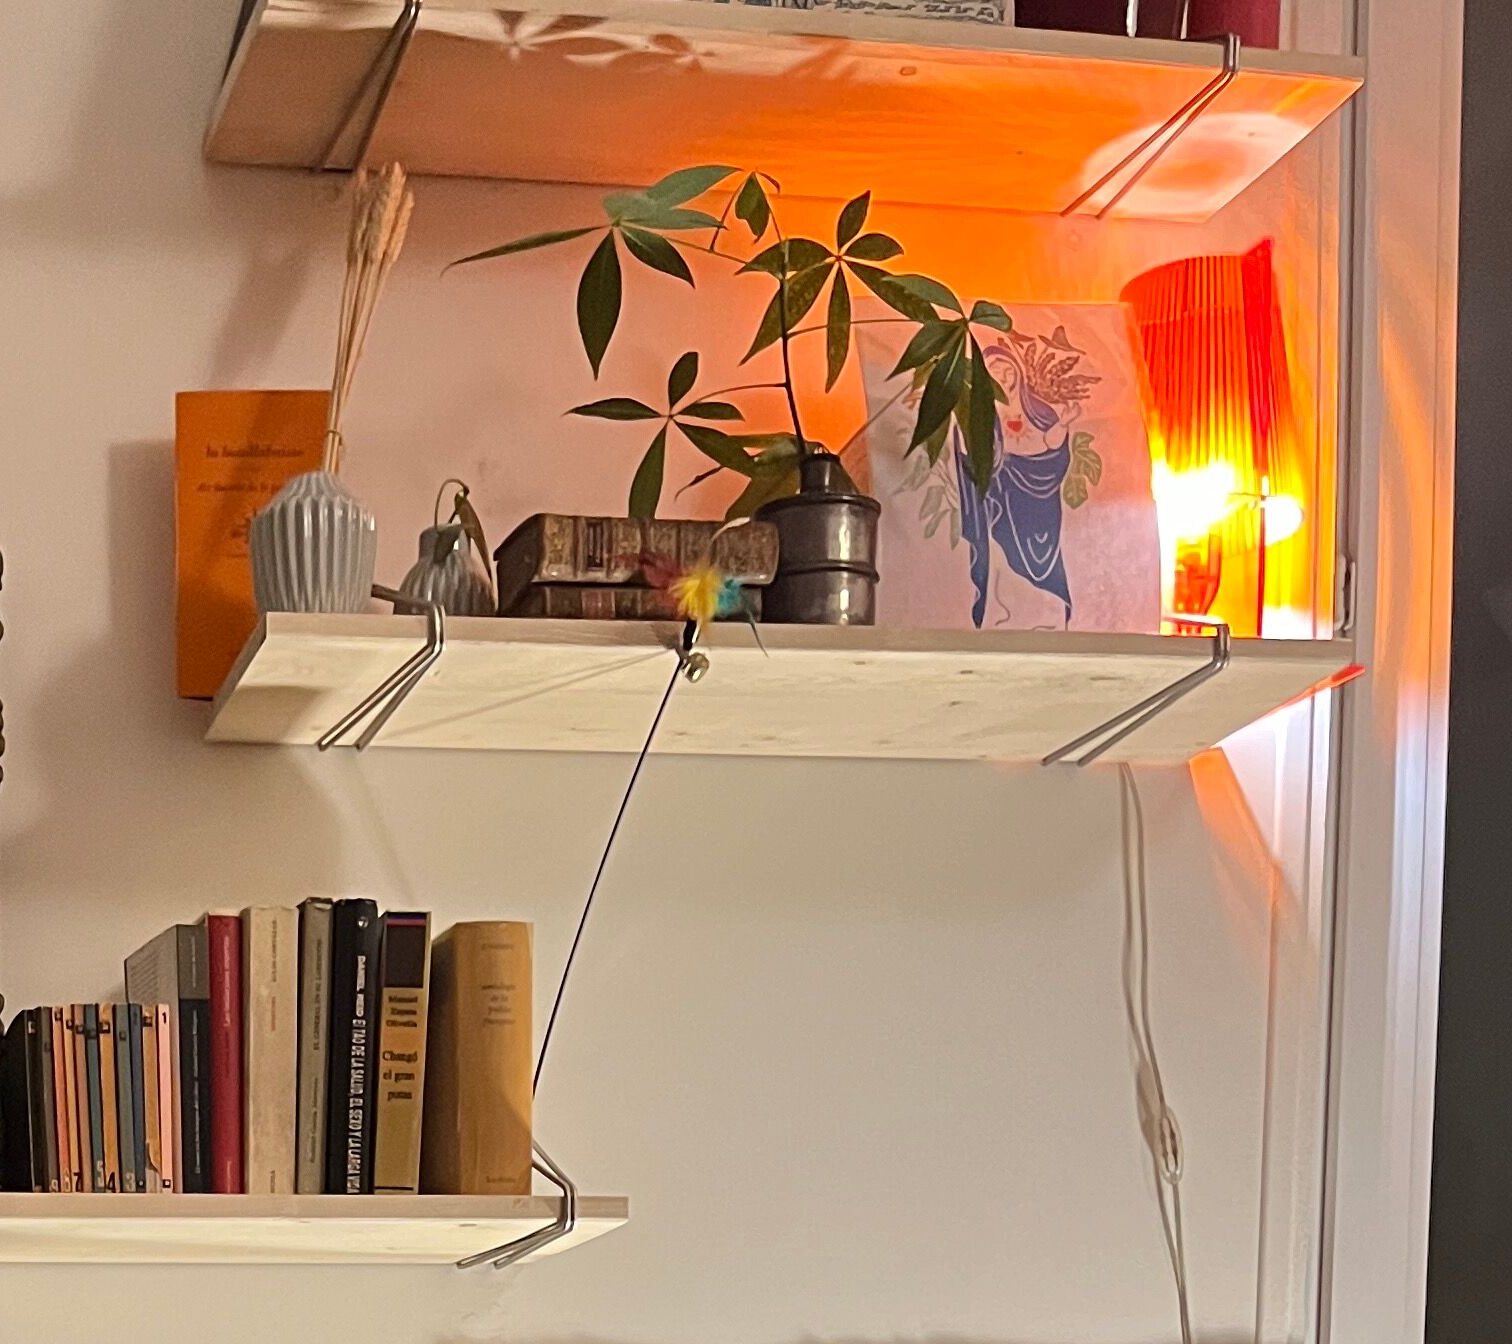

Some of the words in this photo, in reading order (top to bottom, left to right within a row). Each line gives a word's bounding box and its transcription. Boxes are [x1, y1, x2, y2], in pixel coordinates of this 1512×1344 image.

[162, 1011, 167, 1024] 1
[351, 1029, 366, 1044] TAO
[350, 1045, 366, 1057] DE
[350, 1057, 365, 1068] LA
[382, 1069, 392, 1081] el
[394, 1072, 416, 1083] gran
[349, 1097, 364, 1108] EL
[348, 1109, 363, 1131] SEXO
[348, 1138, 362, 1148] LA
[347, 1149, 362, 1175] LARGA
[106, 1171, 117, 1193] 4
